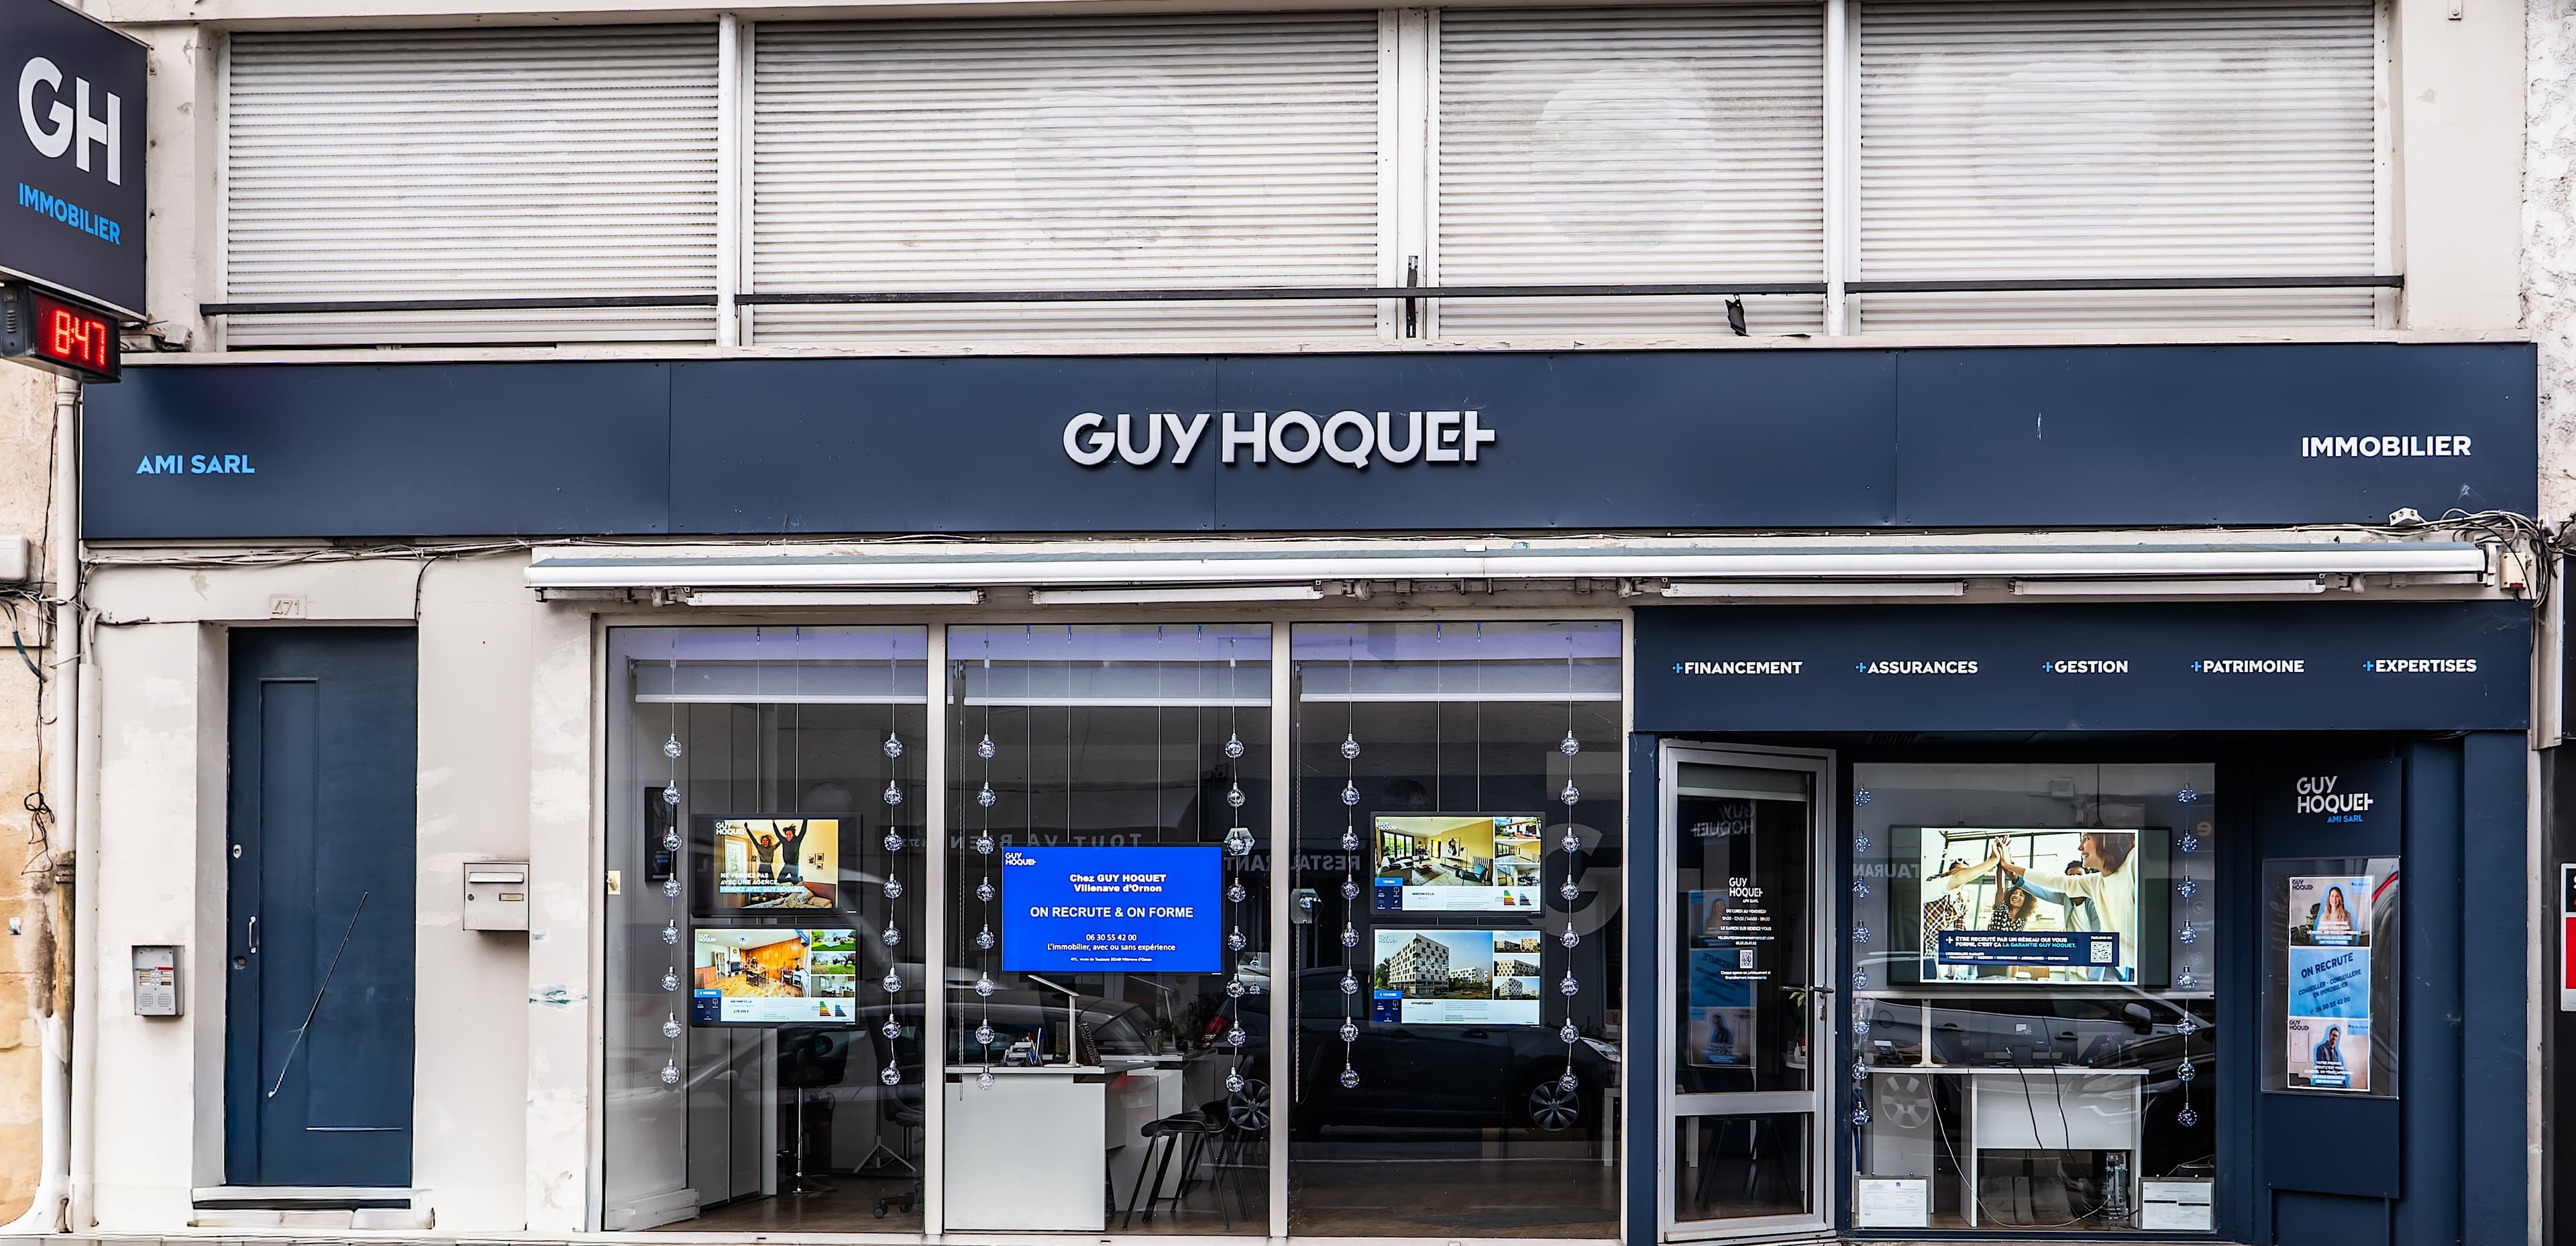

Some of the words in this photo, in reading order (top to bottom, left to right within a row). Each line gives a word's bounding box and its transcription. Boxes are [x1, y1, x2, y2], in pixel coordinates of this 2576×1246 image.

[18, 56, 121, 186] GH
[19, 182, 121, 245] IMMOBILIER
[54, 309, 107, 366] 8:47
[1063, 412, 1210, 465] GUY
[1222, 410, 1496, 469] HOQUET
[2302, 435, 2472, 457] IMMOBILIER
[136, 455, 183, 474] AMI
[191, 454, 256, 474] SARL
[272, 600, 300, 615] 471
[1684, 661, 1803, 675] FINANCEMENT
[1867, 661, 1978, 675] ASSURANCES
[2053, 660, 2129, 673] GESTION
[2203, 659, 2304, 673] PATRIMOINE
[2375, 659, 2477, 673] EXPERTISES
[2296, 776, 2337, 795] GUY
[2327, 815, 2342, 824] AMI
[2343, 815, 2363, 823] SARL
[1069, 874, 1095, 883] Chez
[1097, 874, 1120, 883] GUY
[1122, 874, 1166, 884] HOQUET
[1729, 877, 1748, 887] GUY
[1073, 884, 1120, 893] Villenave
[1030, 907, 1049, 917] ON
[1052, 907, 1112, 917] RECRUTE
[1116, 907, 1124, 917] &
[1127, 907, 1146, 917] ON
[1149, 907, 1193, 917] FORME
[1086, 933, 1095, 942] 06
[1097, 933, 1106, 942] 30
[1107, 933, 1116, 942] 55
[1117, 933, 1126, 942] 42
[1128, 933, 1137, 942] 00
[1138, 943, 1175, 952] expérience
[2301, 966, 2313, 978] ON
[2315, 952, 2354, 974] RECRUTE
[2298, 981, 2326, 995] CONSEILLER
[2320, 981, 2349, 996] IMMOBILIER
